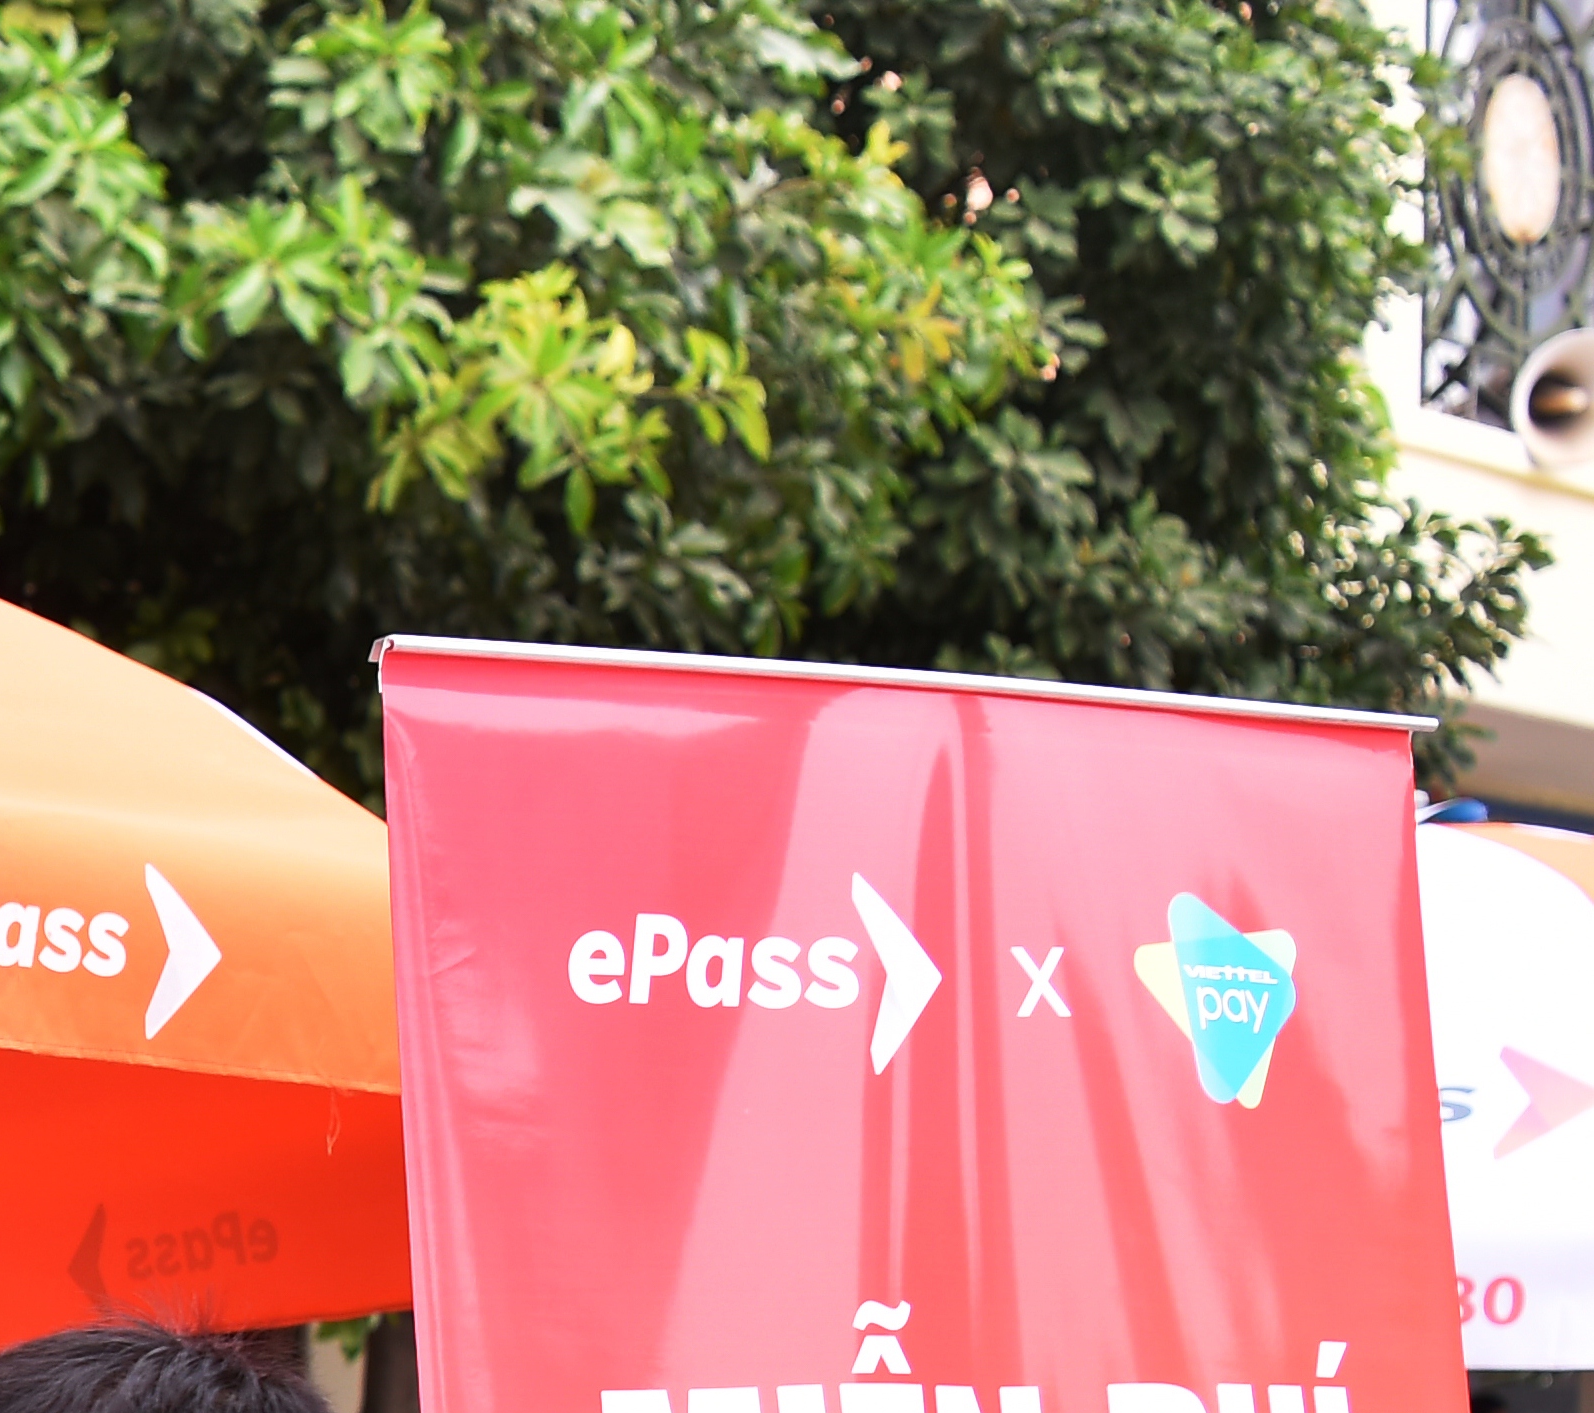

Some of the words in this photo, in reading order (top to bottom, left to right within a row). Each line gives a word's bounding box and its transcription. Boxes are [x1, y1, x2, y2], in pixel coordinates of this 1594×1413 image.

[568, 914, 860, 1009] ePass
[1183, 963, 1279, 985] VIETTEL
[1195, 986, 1270, 1034] pay
